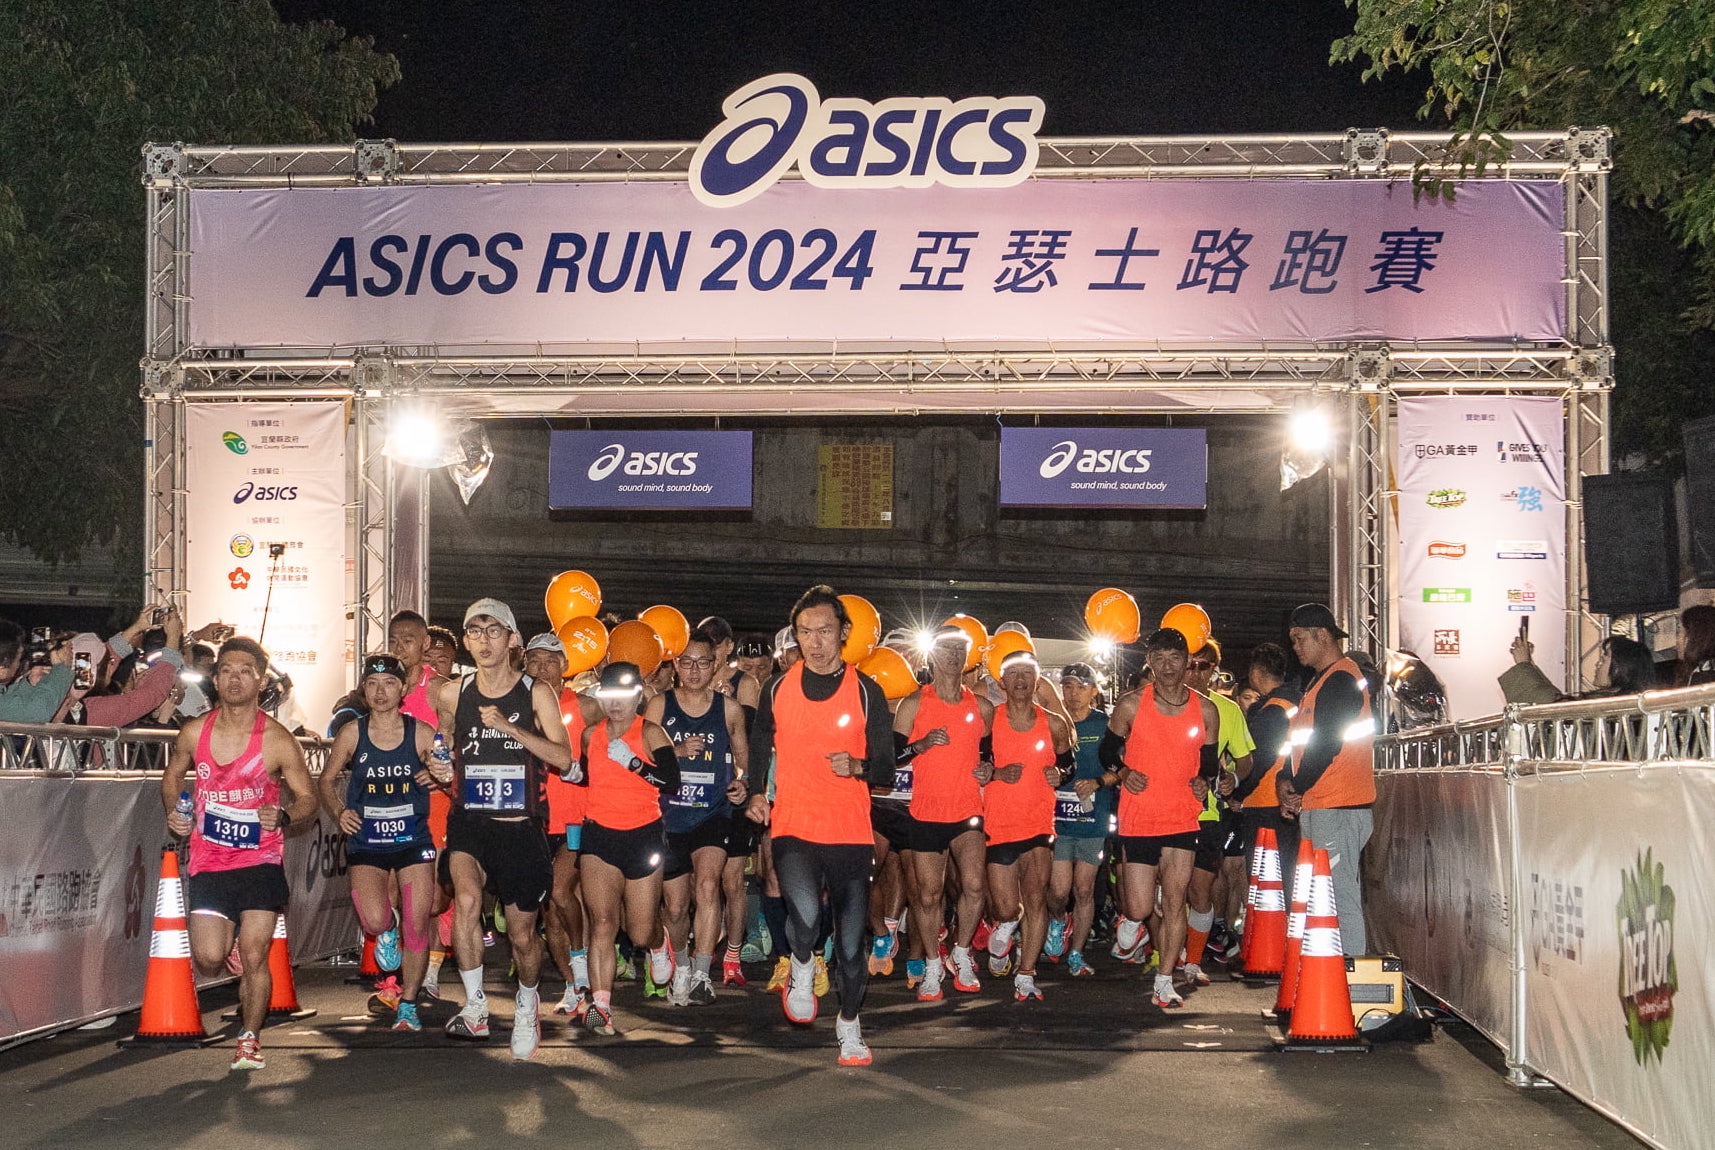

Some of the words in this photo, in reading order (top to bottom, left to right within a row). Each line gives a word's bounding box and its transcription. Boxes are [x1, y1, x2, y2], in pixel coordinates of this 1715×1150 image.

[809, 107, 1034, 177] asics
[305, 233, 523, 299] ASICS
[535, 231, 692, 293] RUN
[699, 228, 878, 292] 2024
[898, 226, 1445, 294] 亞瑟士路跑賽
[623, 452, 698, 476] asics
[1076, 449, 1152, 473] asics
[254, 486, 298, 500] asics
[617, 483, 643, 492] sound
[643, 483, 665, 493] mind,
[666, 483, 691, 493] sound
[692, 483, 713, 493] body
[1070, 481, 1096, 489] sound
[1097, 481, 1119, 490] mind,
[1119, 482, 1145, 490] sound
[1146, 481, 1168, 491] body
[366, 764, 412, 778] ASICS
[476, 781, 513, 796] 133
[214, 820, 249, 838] 1310
[373, 820, 405, 833] 1030
